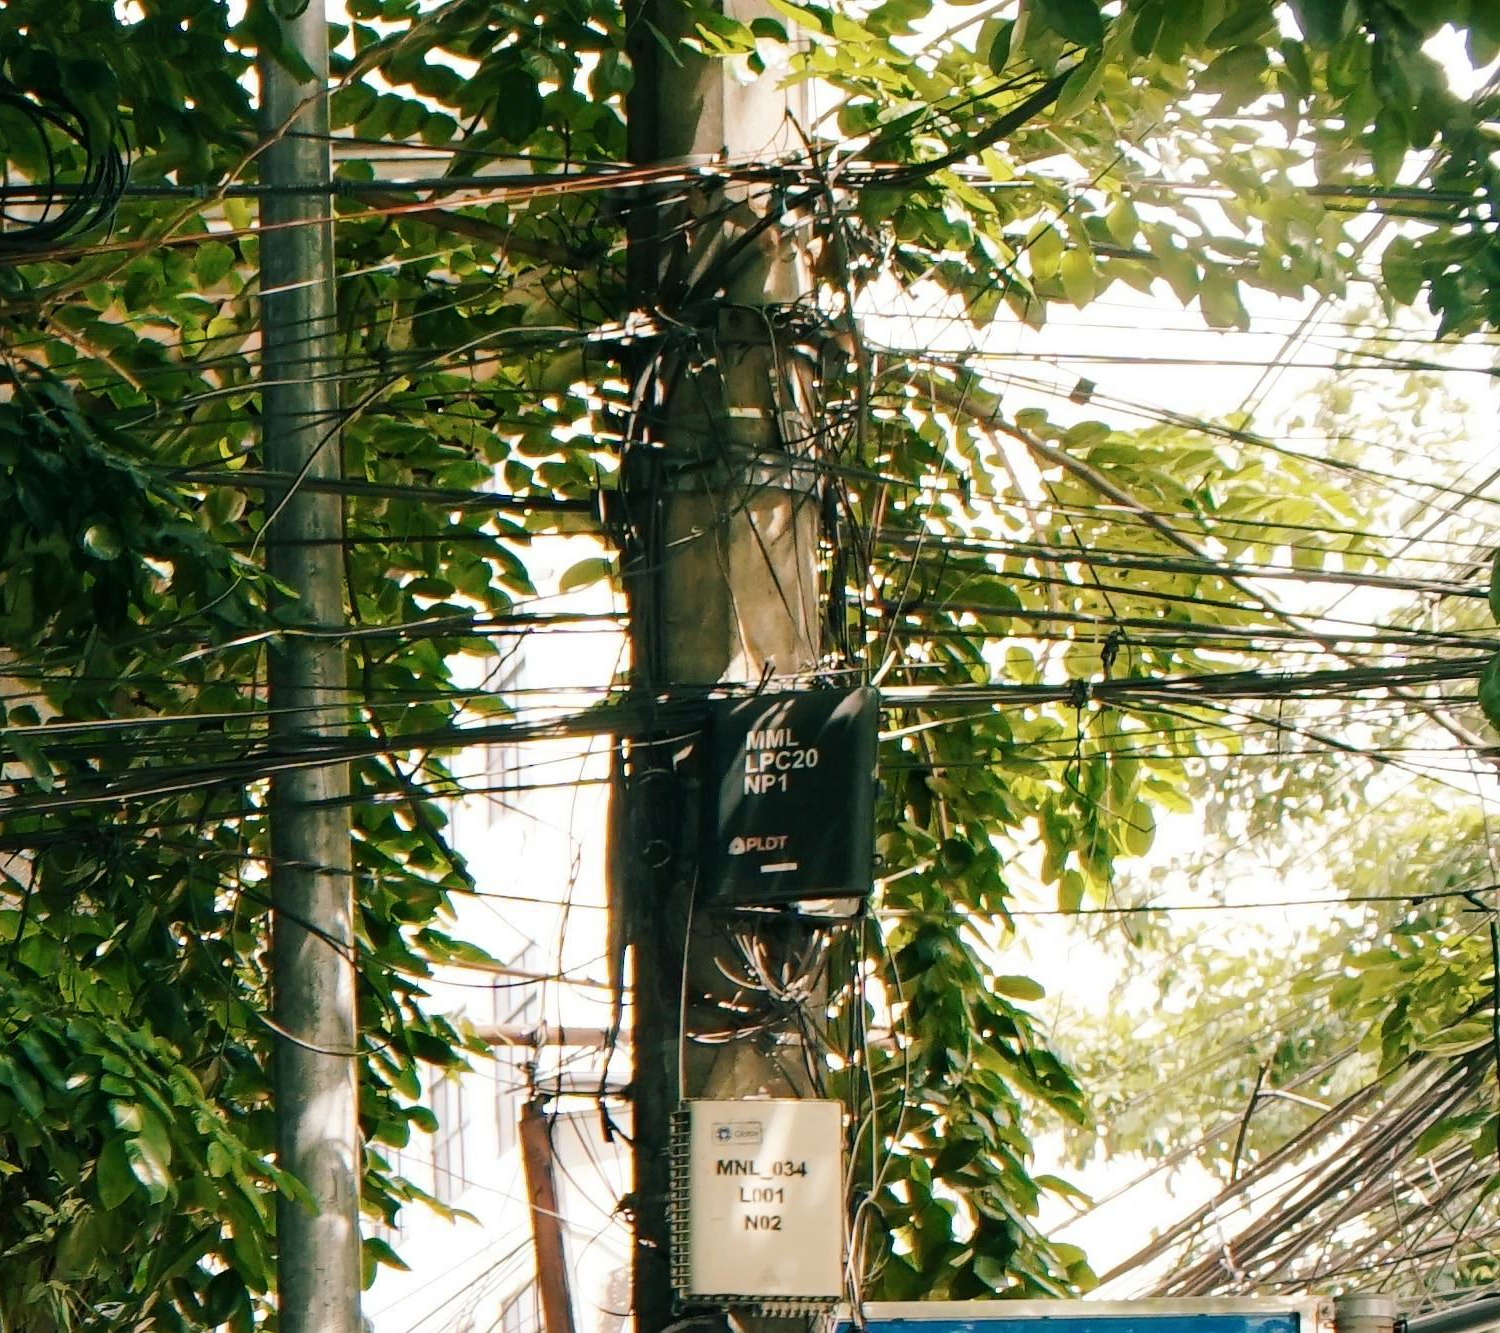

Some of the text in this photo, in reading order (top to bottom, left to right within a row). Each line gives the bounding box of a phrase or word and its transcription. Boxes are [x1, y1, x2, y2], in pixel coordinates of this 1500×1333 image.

[746, 728, 799, 750] MML
[745, 749, 818, 773] LPC20
[744, 774, 788, 795] NP1
[744, 836, 788, 852] PLDT
[716, 1159, 808, 1180] MNL_034
[740, 1187, 784, 1203] L001
[745, 1215, 782, 1231] N02
